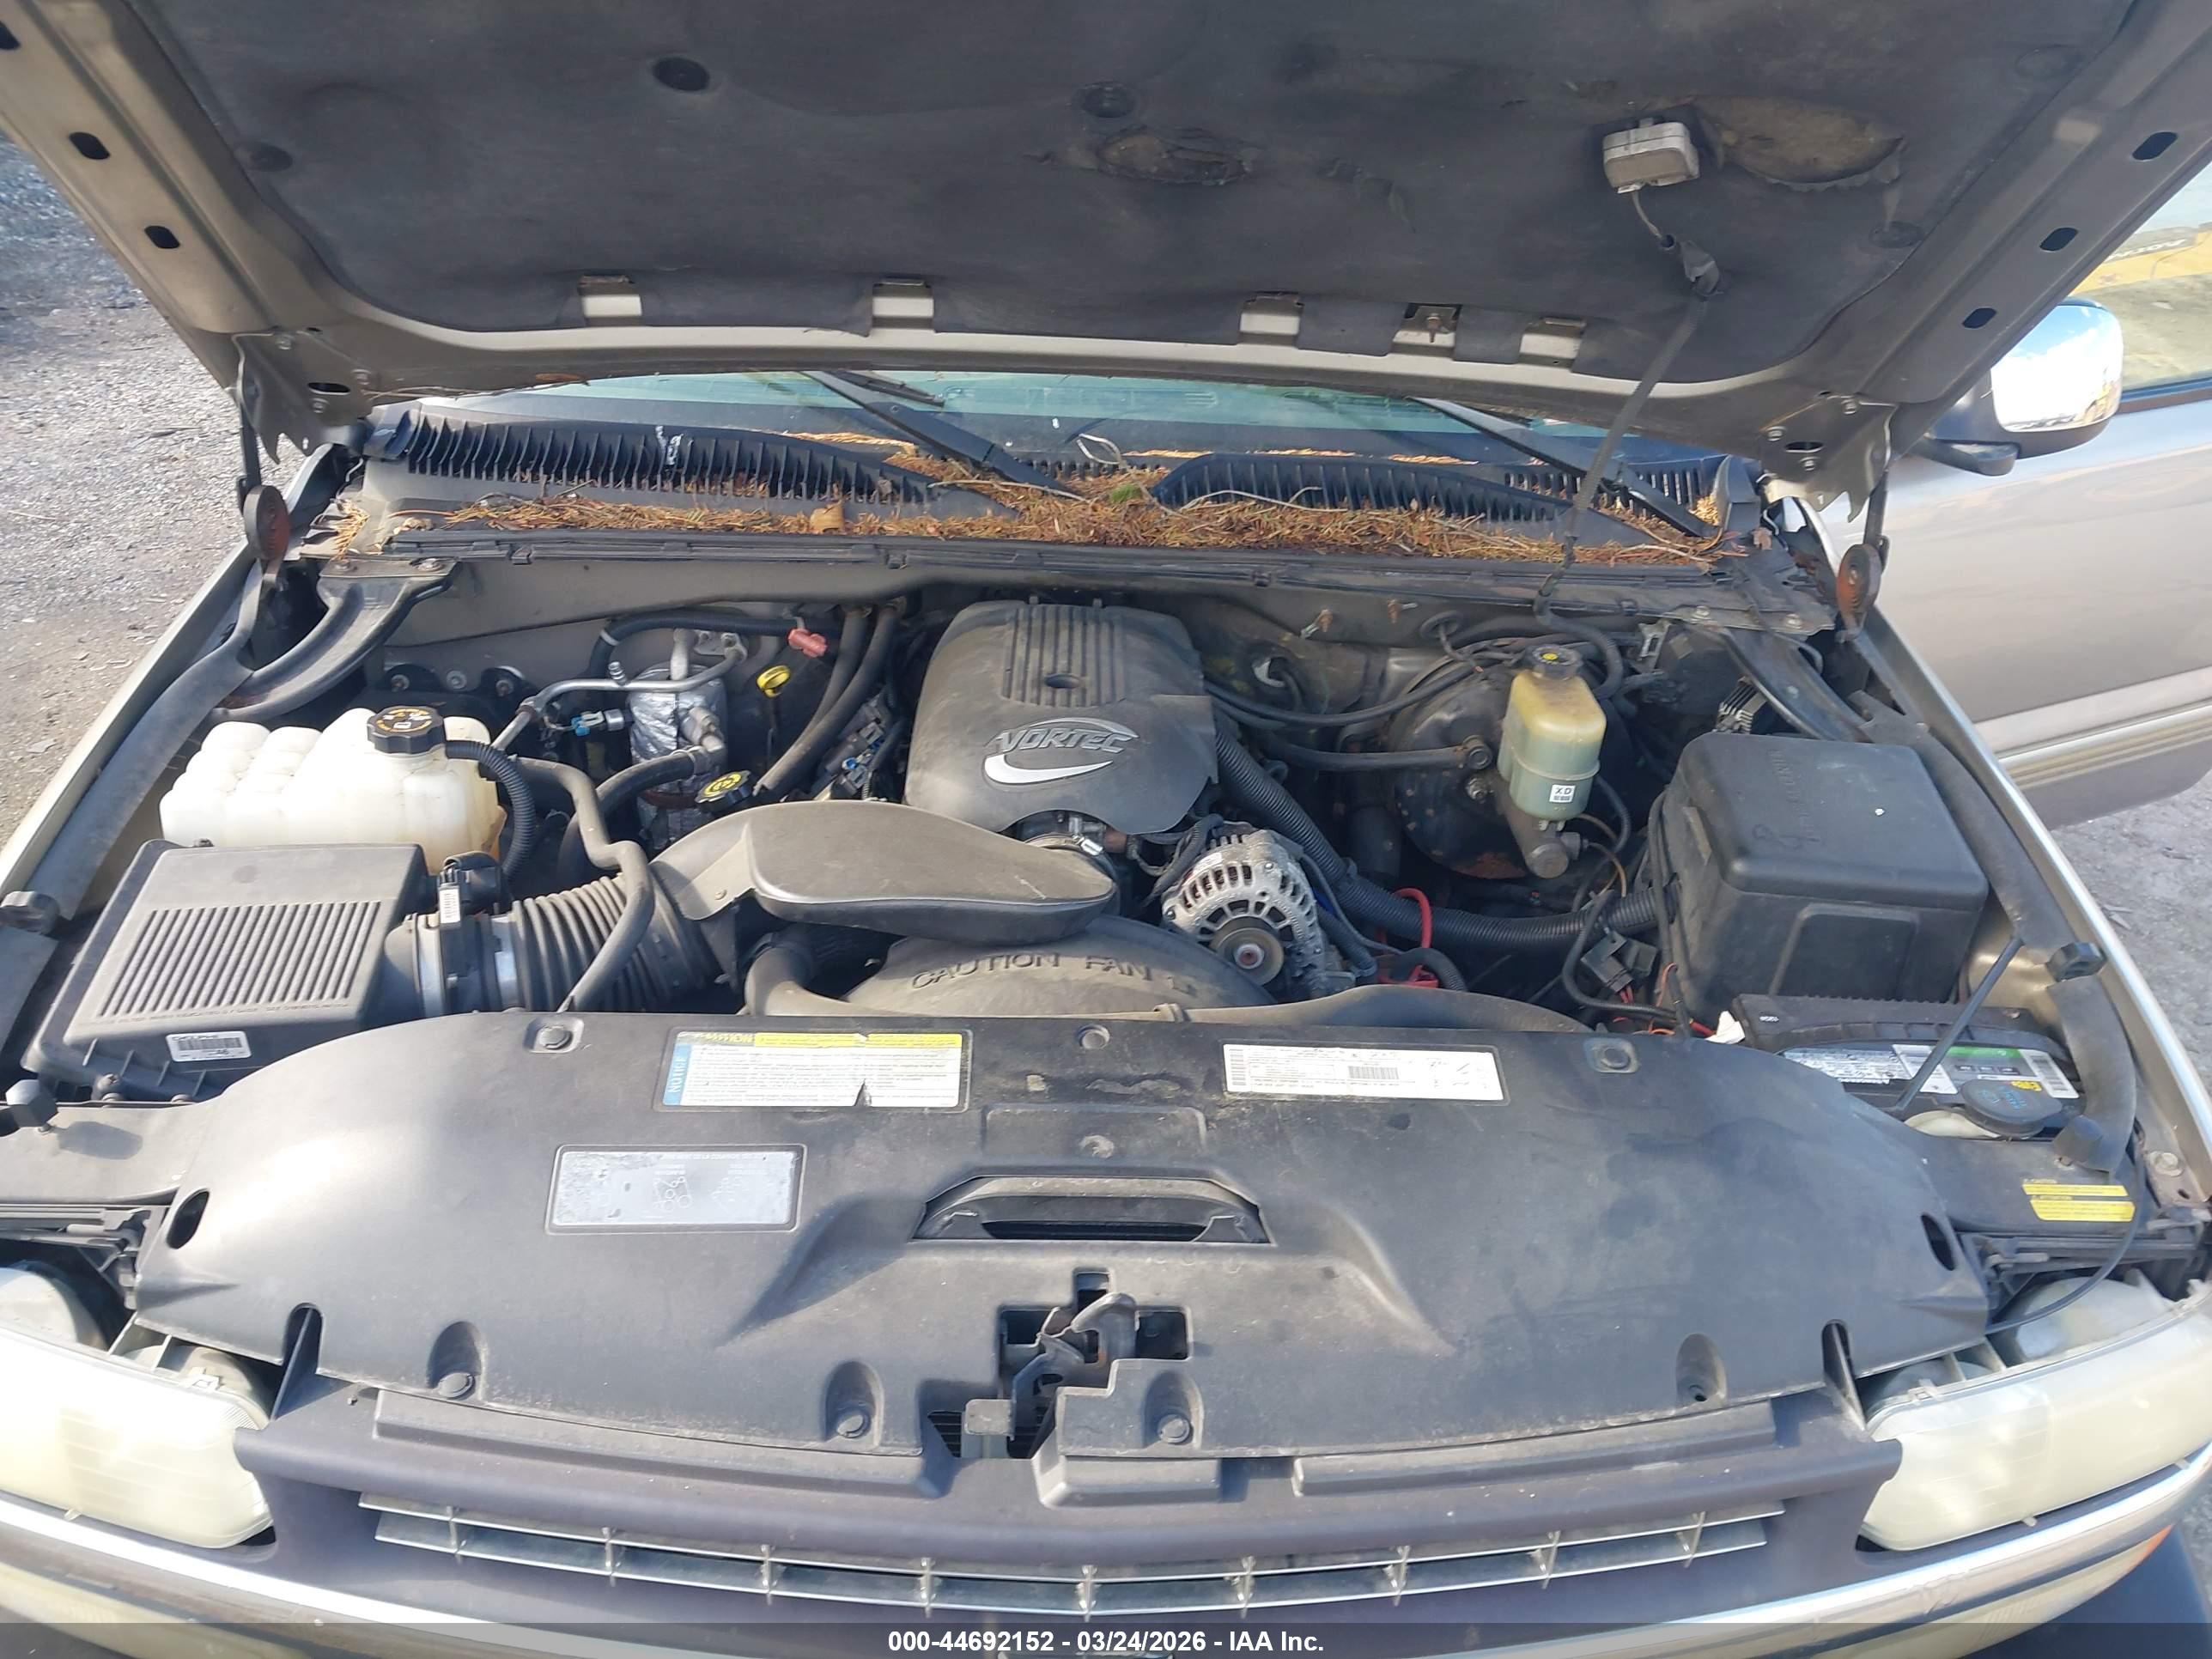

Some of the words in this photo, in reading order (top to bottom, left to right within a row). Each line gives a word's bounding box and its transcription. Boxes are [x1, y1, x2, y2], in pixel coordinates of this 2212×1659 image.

[996, 729, 1133, 753] VORTEC
[912, 952, 1060, 989] CAUTION
[1085, 955, 1152, 981] FAN
[668, 1058, 687, 1092] NOTICE
